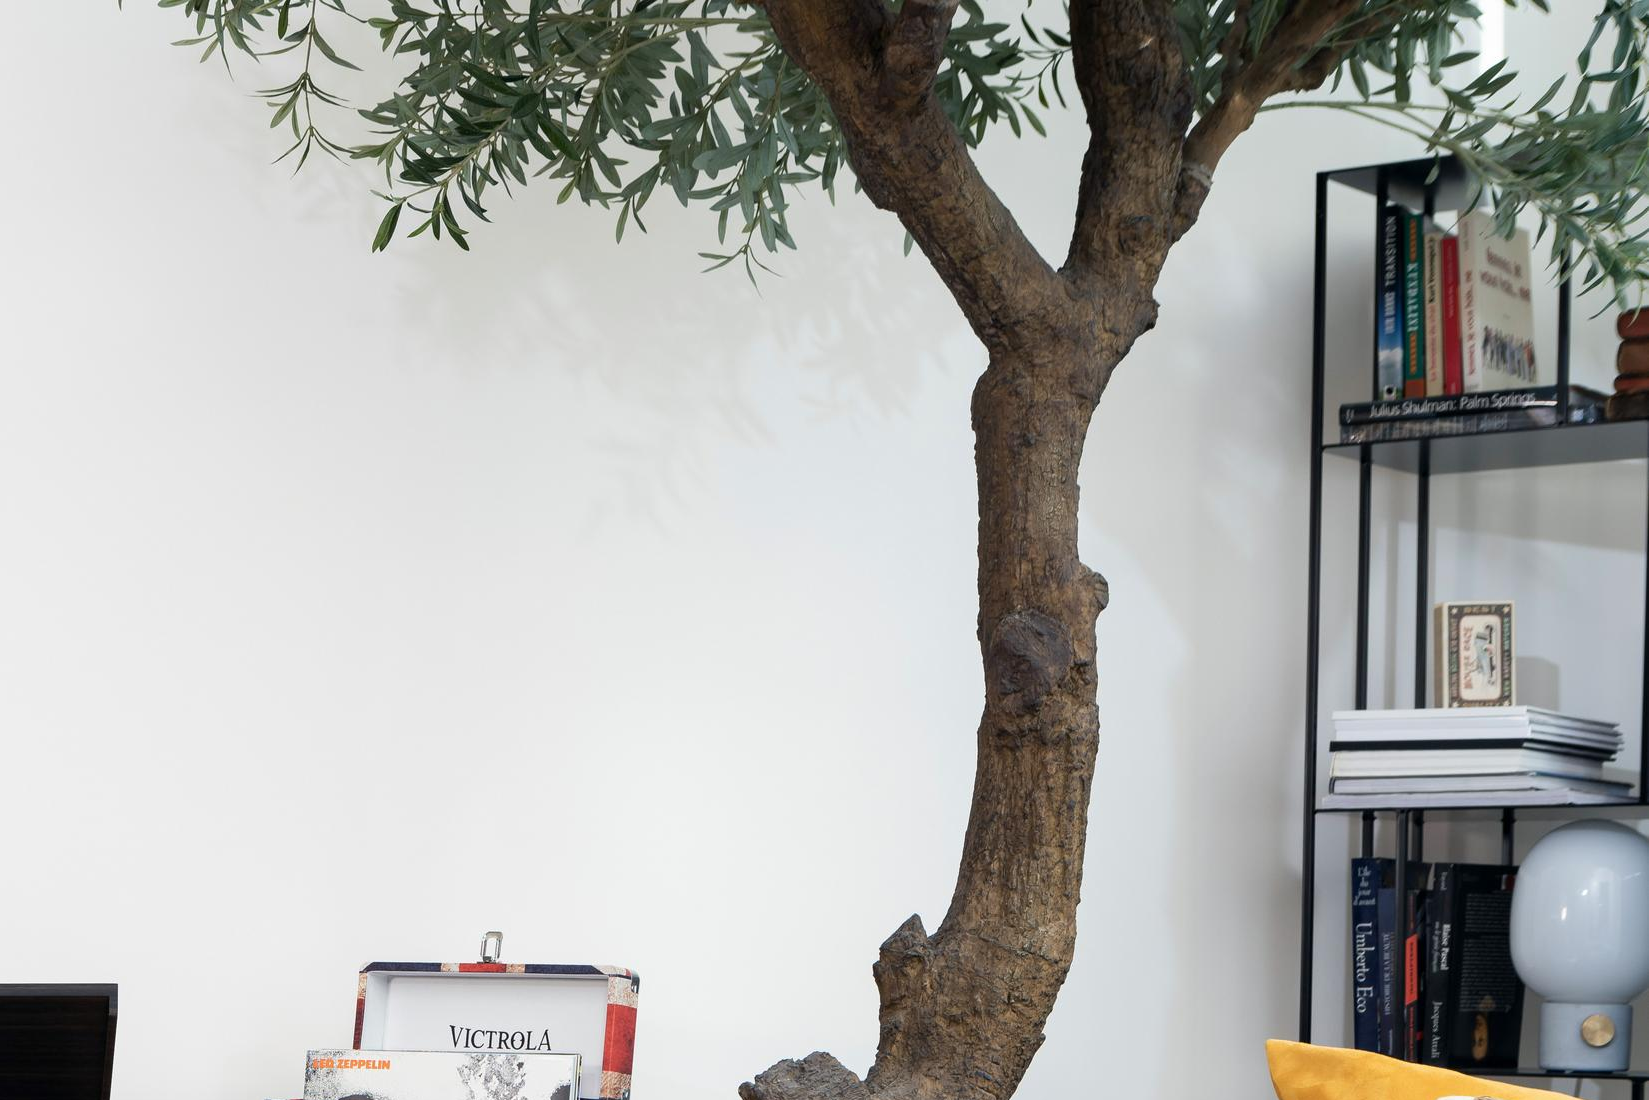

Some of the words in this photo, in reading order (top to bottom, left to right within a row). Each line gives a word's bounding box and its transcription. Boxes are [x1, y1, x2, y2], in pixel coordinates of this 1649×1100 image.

[1384, 215, 1397, 286] TRANSITION
[1406, 262, 1419, 333] KUNDALINI
[1369, 403, 1400, 418] Julius
[1401, 398, 1457, 416] Shulman:
[1459, 395, 1490, 410] Palm
[1491, 391, 1536, 407] Springs
[1441, 923, 1451, 947] Blaise
[1355, 921, 1376, 983] Umberto
[1440, 947, 1450, 971] Pascal
[1356, 987, 1374, 1013] Eco
[1431, 1000, 1443, 1033] Jacques
[449, 1024, 552, 1050] VICTROLA
[1430, 1034, 1441, 1059] Attali
[312, 1059, 335, 1070] LED
[337, 1059, 391, 1070] ZEPPELIN
